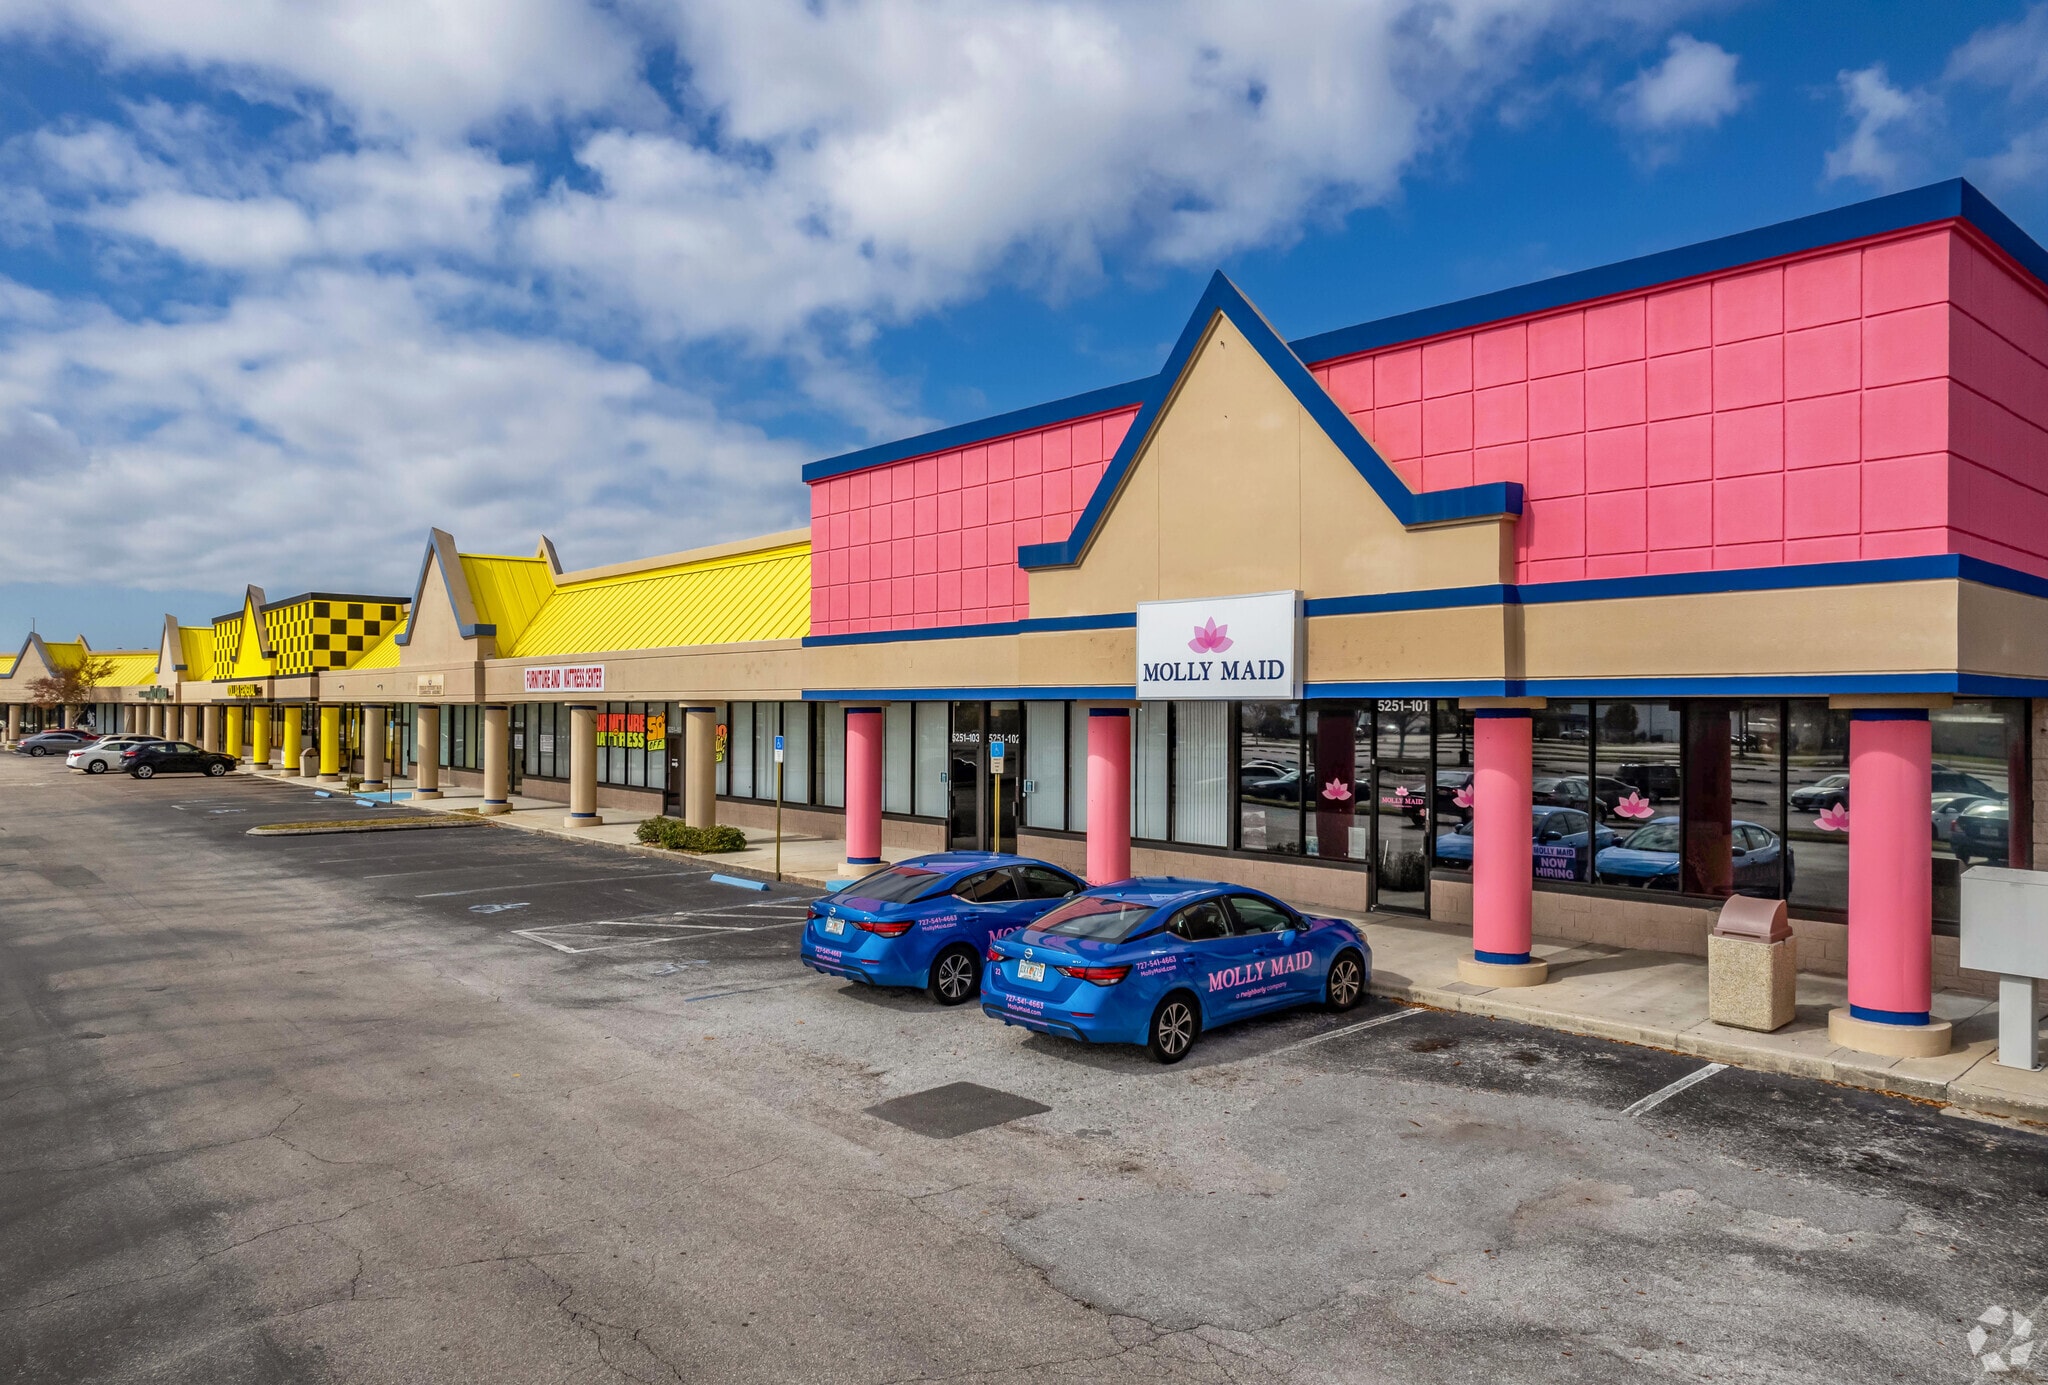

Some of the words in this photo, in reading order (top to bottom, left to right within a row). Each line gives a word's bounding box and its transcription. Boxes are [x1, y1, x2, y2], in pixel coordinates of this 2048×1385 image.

[1143, 661, 1213, 682] MOLLY
[1220, 659, 1285, 681] MAID
[526, 670, 550, 689] FURNITURE
[551, 669, 561, 688] AND
[563, 668, 585, 688] MATTRESS
[586, 667, 602, 688] CENTER
[1377, 699, 1428, 712] 5251-101
[596, 713, 645, 732] URNITURE
[952, 733, 980, 743] 5251-103
[988, 733, 1019, 744] 5251-102
[1556, 848, 1574, 856] MAID
[1540, 857, 1567, 869] NOW
[1535, 867, 1575, 880] HIRING
[1136, 955, 1177, 971] 727-541-4663
[1140, 964, 1177, 977] MollyMaid.com
[1208, 960, 1266, 993] MOLLY
[1270, 950, 1313, 978] MAID
[1240, 985, 1267, 998] neighborly
[1267, 981, 1288, 992] company
[1005, 993, 1045, 1010] 727-541-4663
[1007, 1003, 1042, 1016] MollyMaid.com
